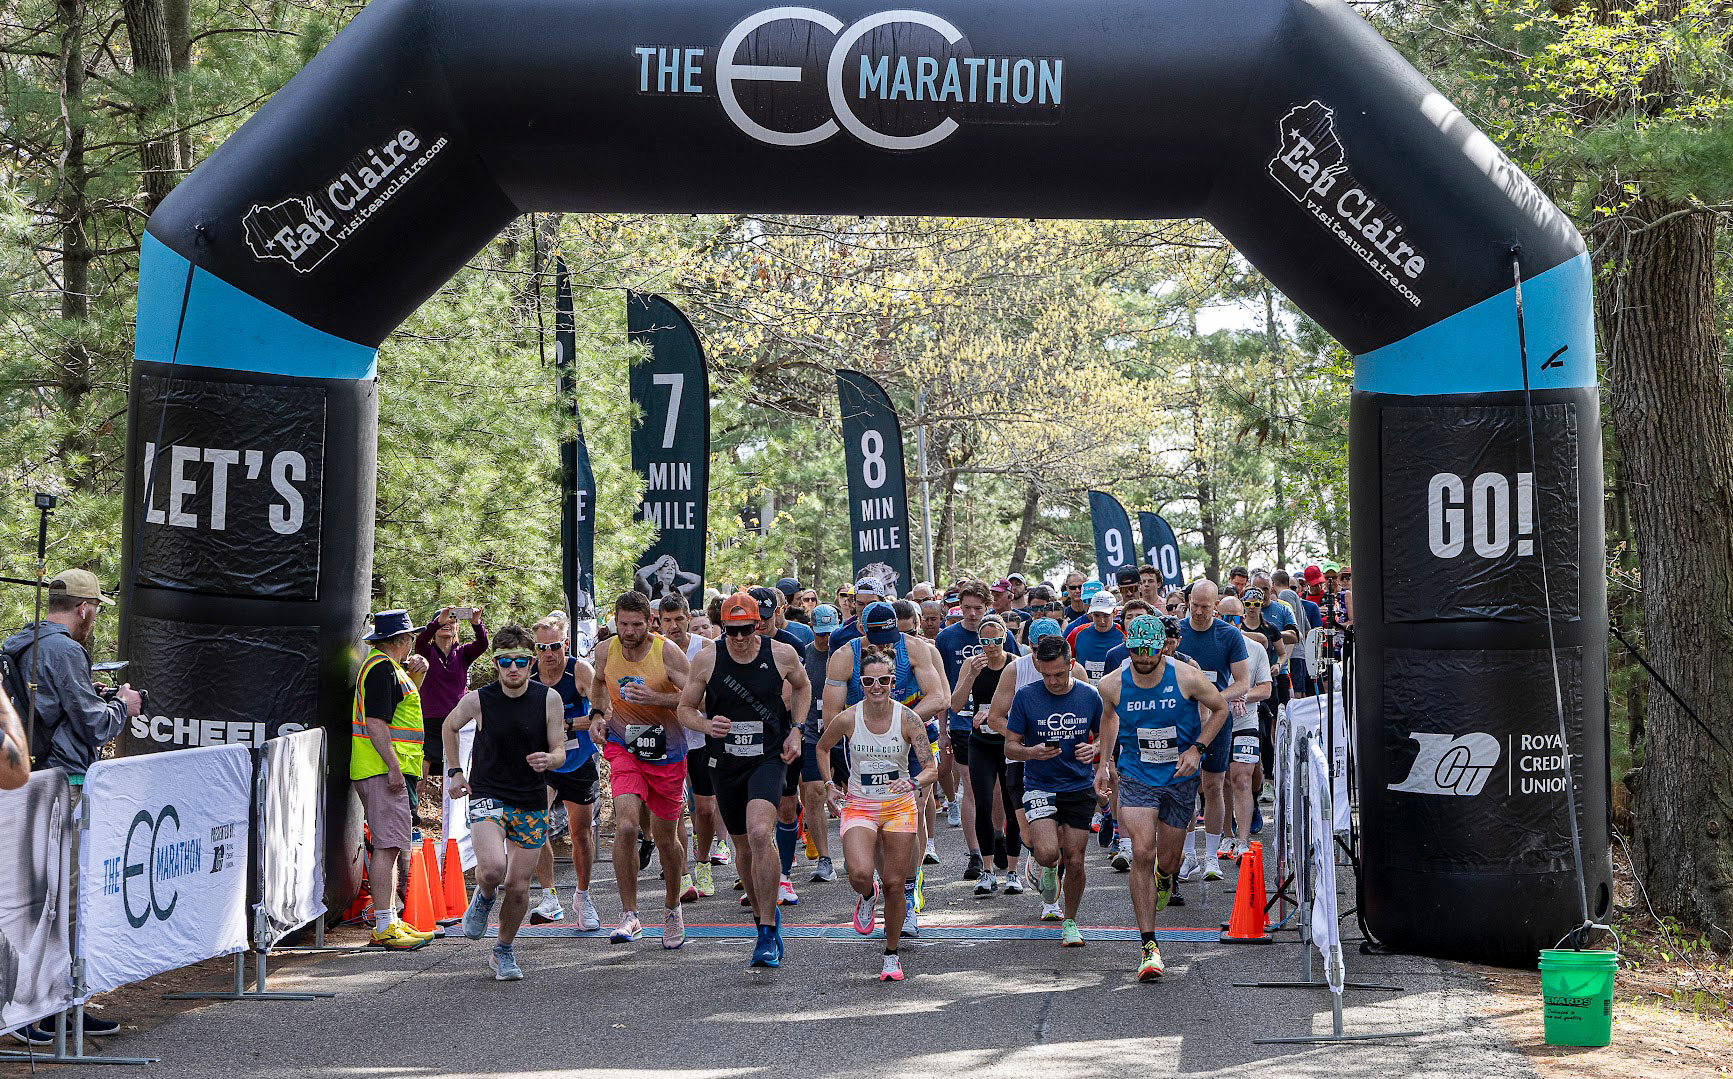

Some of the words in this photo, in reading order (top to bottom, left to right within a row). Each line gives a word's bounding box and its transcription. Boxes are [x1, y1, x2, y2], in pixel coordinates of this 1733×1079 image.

[634, 46, 704, 94] THE
[858, 54, 1064, 105] MARATHON
[273, 208, 335, 261] Eau
[328, 129, 422, 212] Claire
[335, 136, 449, 241] visiteauclaire.com
[1281, 136, 1337, 197] Eau
[1336, 188, 1426, 280] Claire
[1306, 199, 1422, 308] visiteauclaire.com
[652, 373, 685, 449] 7
[649, 462, 691, 491] MIN
[860, 429, 887, 489] 8
[143, 441, 307, 536] LET'S
[861, 496, 894, 522] MIN
[643, 501, 696, 530] MILE
[858, 526, 901, 553] MILE
[1428, 471, 1533, 559] GO!
[1104, 527, 1125, 567] 9
[1147, 543, 1178, 579] 10
[1126, 700, 1156, 711] EOLA
[1159, 698, 1177, 709] TC
[853, 744, 874, 753] NORTH
[1147, 740, 1169, 749] 503
[1520, 734, 1570, 751] ROYA
[103, 856, 121, 896] THE
[156, 837, 202, 882] MARATHON
